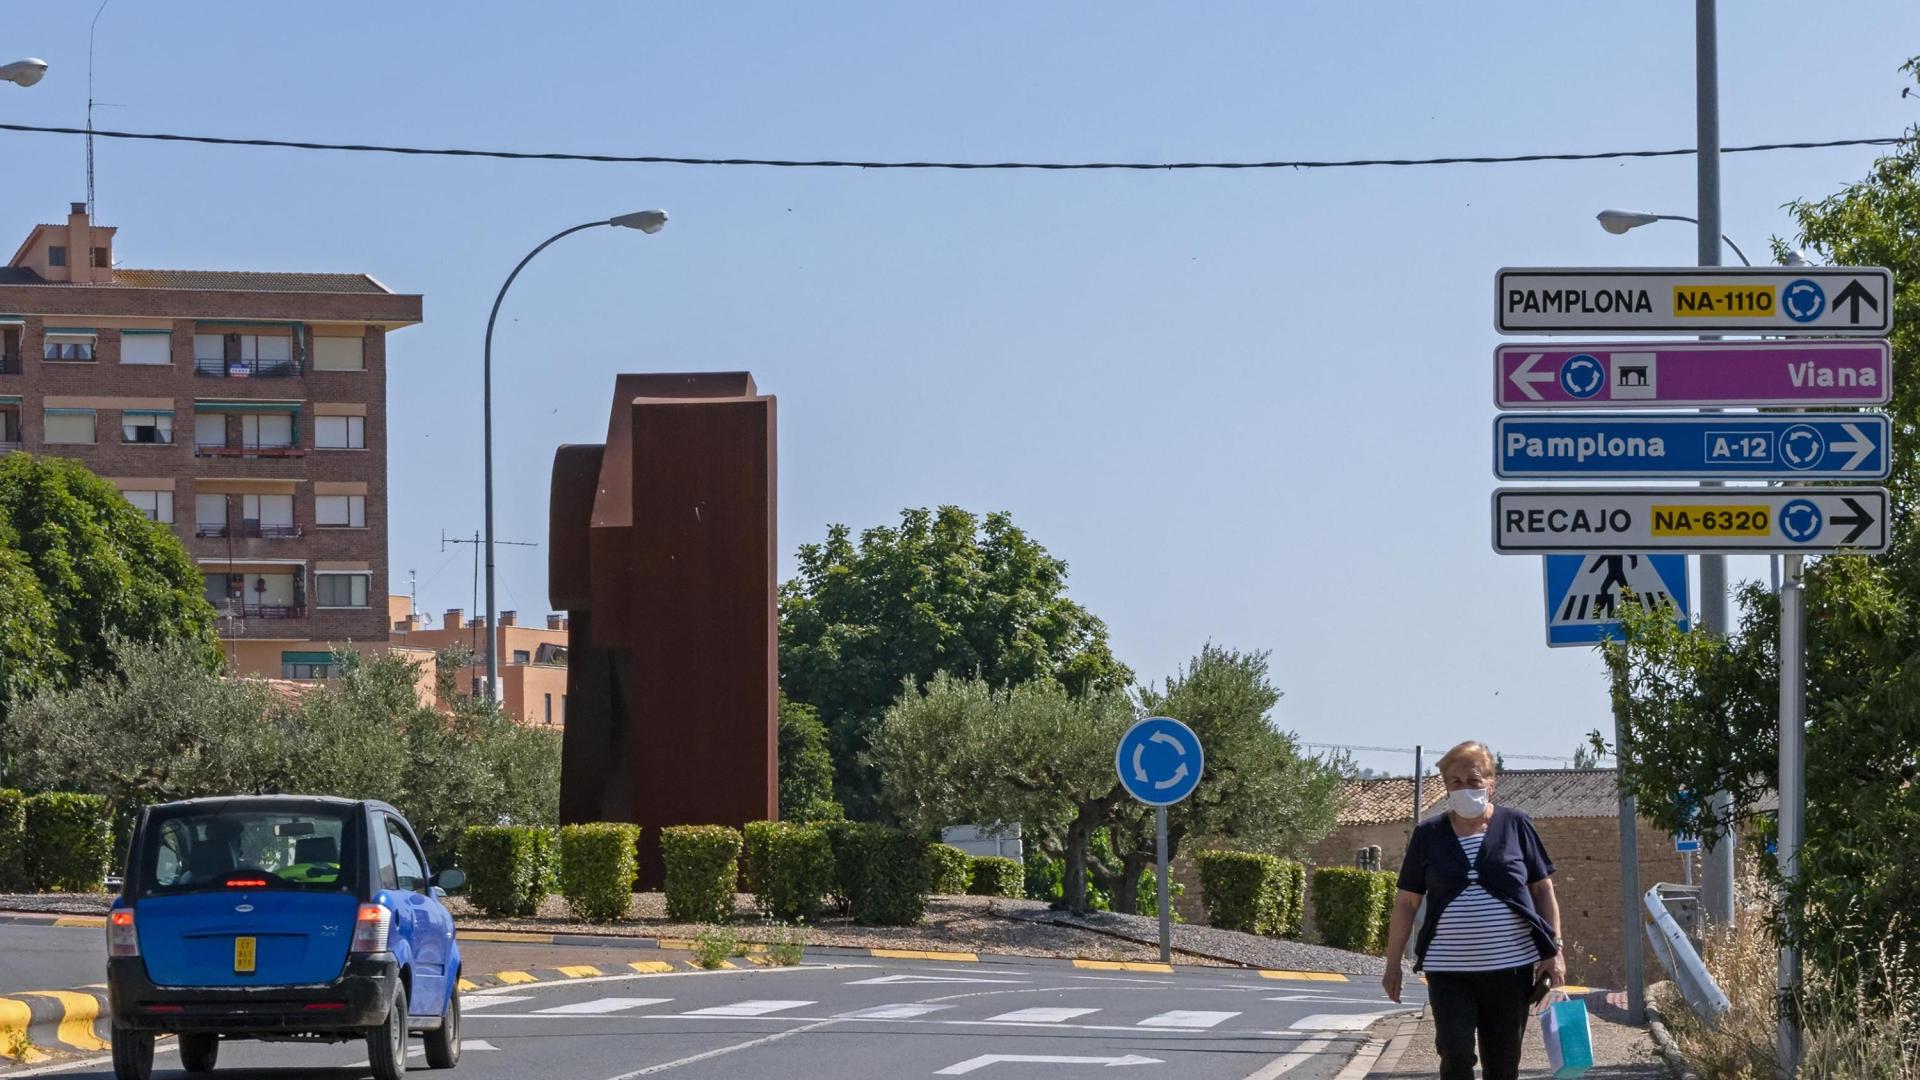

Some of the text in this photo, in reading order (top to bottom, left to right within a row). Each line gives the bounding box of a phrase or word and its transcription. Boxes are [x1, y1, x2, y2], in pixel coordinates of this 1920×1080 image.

[1508, 289, 1773, 313] PAMPLONA NA-1110
[1787, 361, 1878, 387] Viana
[1506, 432, 1767, 463] Pamplona A-12
[1505, 508, 1769, 533] RECAJO NA-6320
